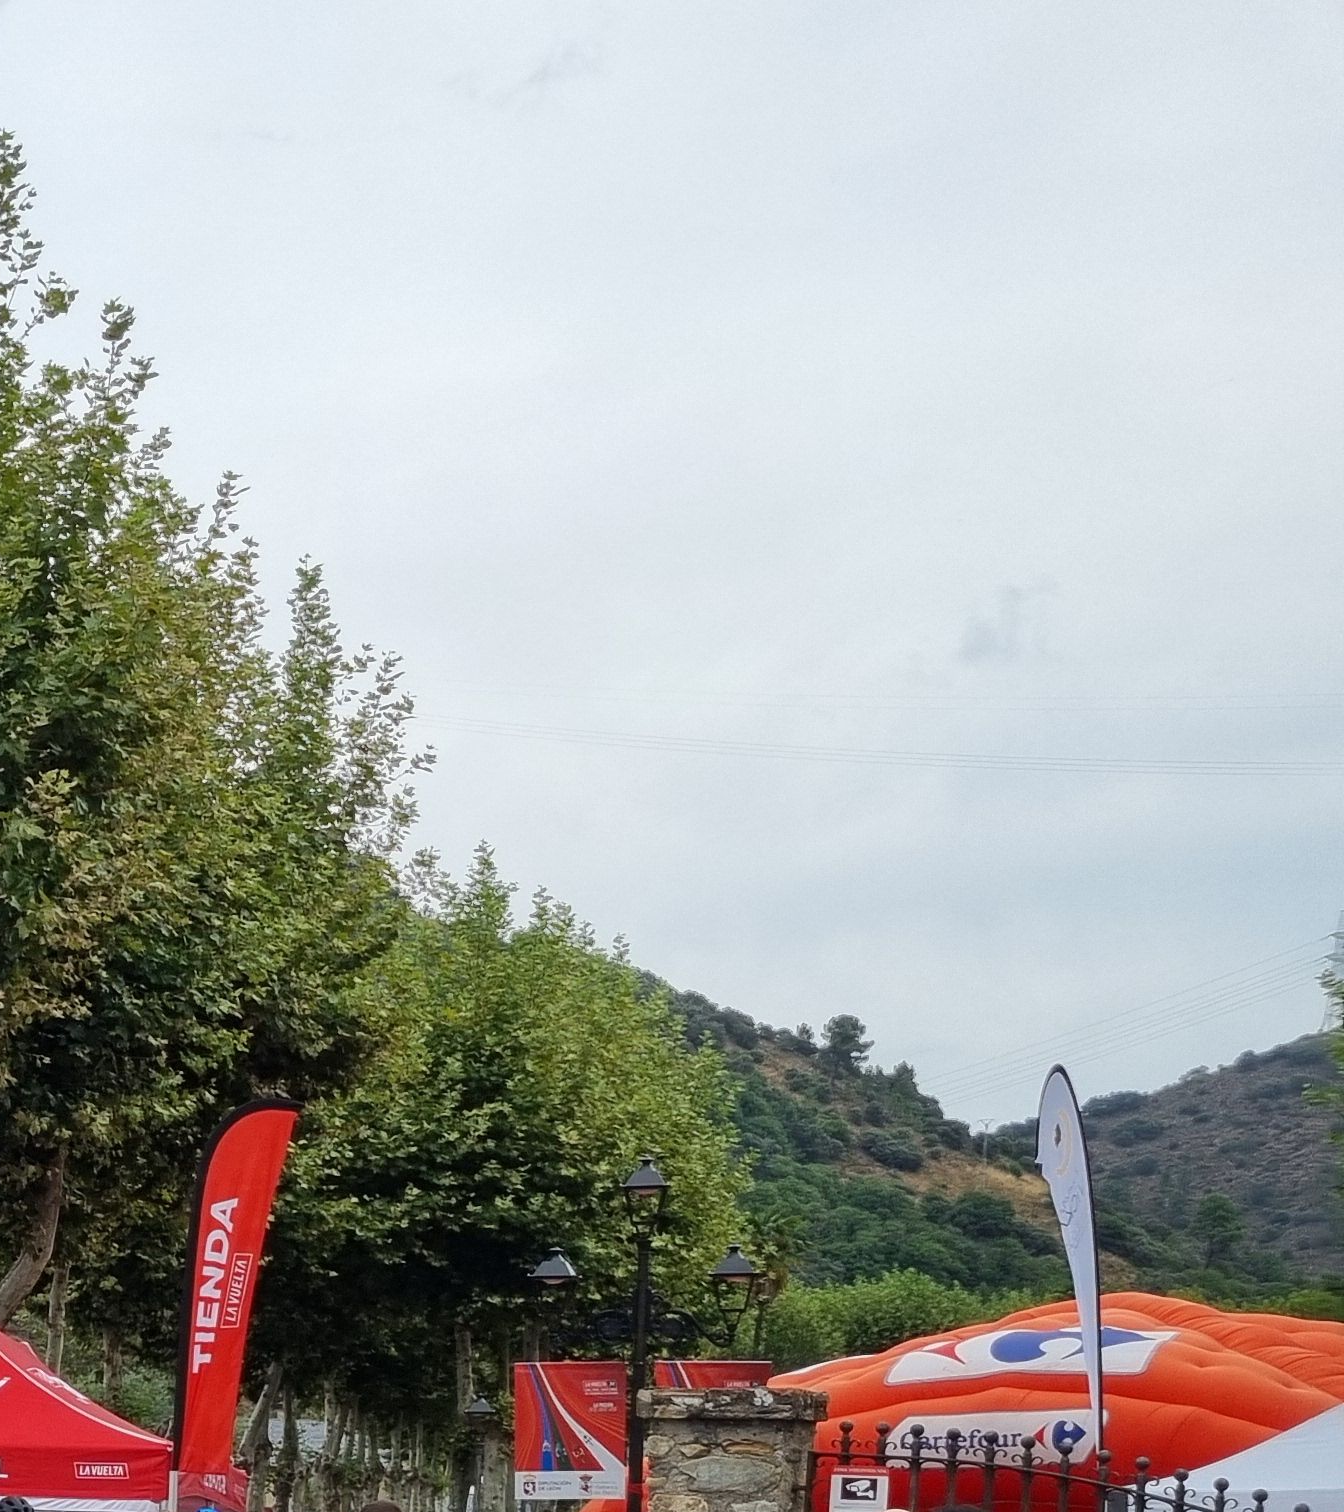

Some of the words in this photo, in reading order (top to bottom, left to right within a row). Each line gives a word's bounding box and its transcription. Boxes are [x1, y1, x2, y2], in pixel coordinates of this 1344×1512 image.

[192, 1198, 239, 1374] TIENDA
[229, 1259, 248, 1305] VUELTA
[225, 1305, 239, 1322] LA
[79, 1465, 91, 1476] LA
[91, 1465, 124, 1476] VUELTA
